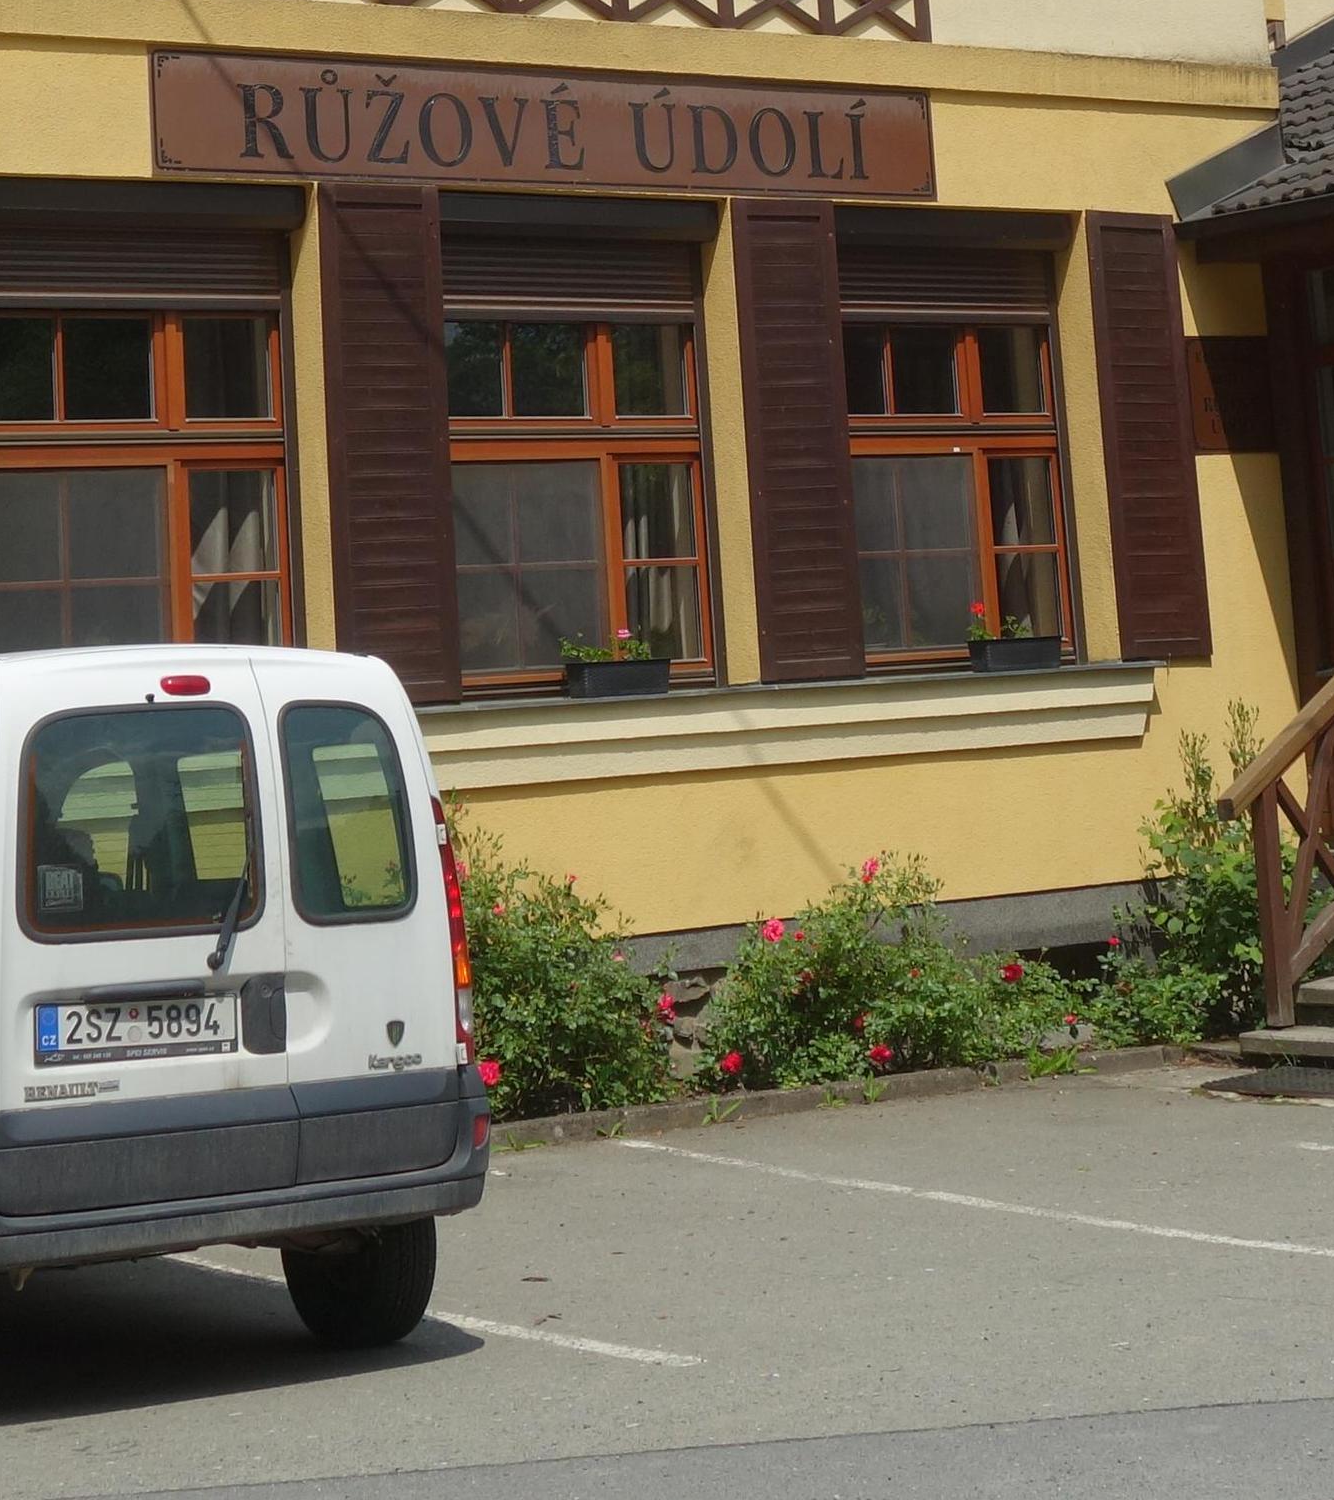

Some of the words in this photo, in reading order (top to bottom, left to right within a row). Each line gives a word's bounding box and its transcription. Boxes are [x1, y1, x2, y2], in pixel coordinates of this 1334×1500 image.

[237, 68, 587, 171] RŮŽOVÉ
[627, 86, 871, 180] ÚDOLÍ
[65, 1007, 123, 1045] 2SZ
[146, 1003, 220, 1040] 5894
[41, 1035, 57, 1046] CZ
[368, 1053, 423, 1071] Kangoo
[23, 1081, 98, 1103] RENAULT
